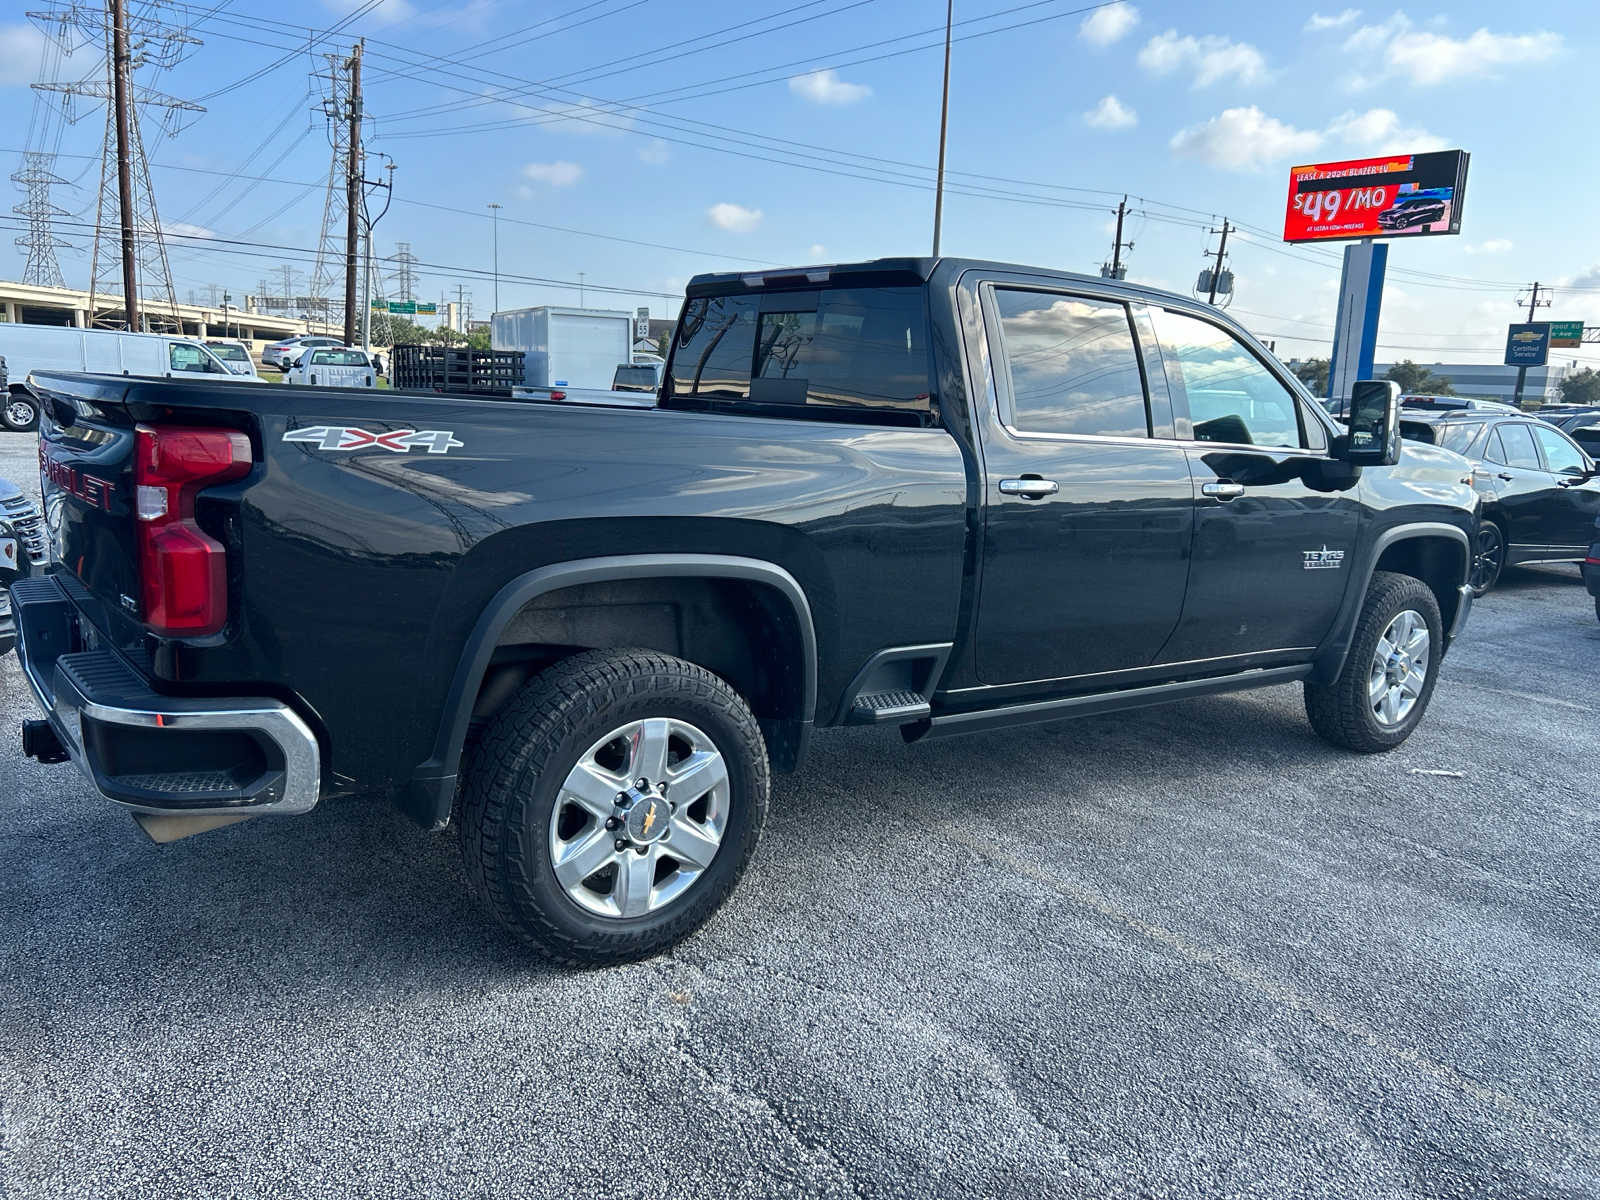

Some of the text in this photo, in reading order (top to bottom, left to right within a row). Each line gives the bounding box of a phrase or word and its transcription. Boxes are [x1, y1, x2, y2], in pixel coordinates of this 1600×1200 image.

[1296, 171, 1317, 182] LEASE
[1318, 170, 1325, 180] A
[1326, 168, 1347, 179] 2024
[1348, 166, 1377, 177] BLAZER
[639, 325, 647, 335] 55
